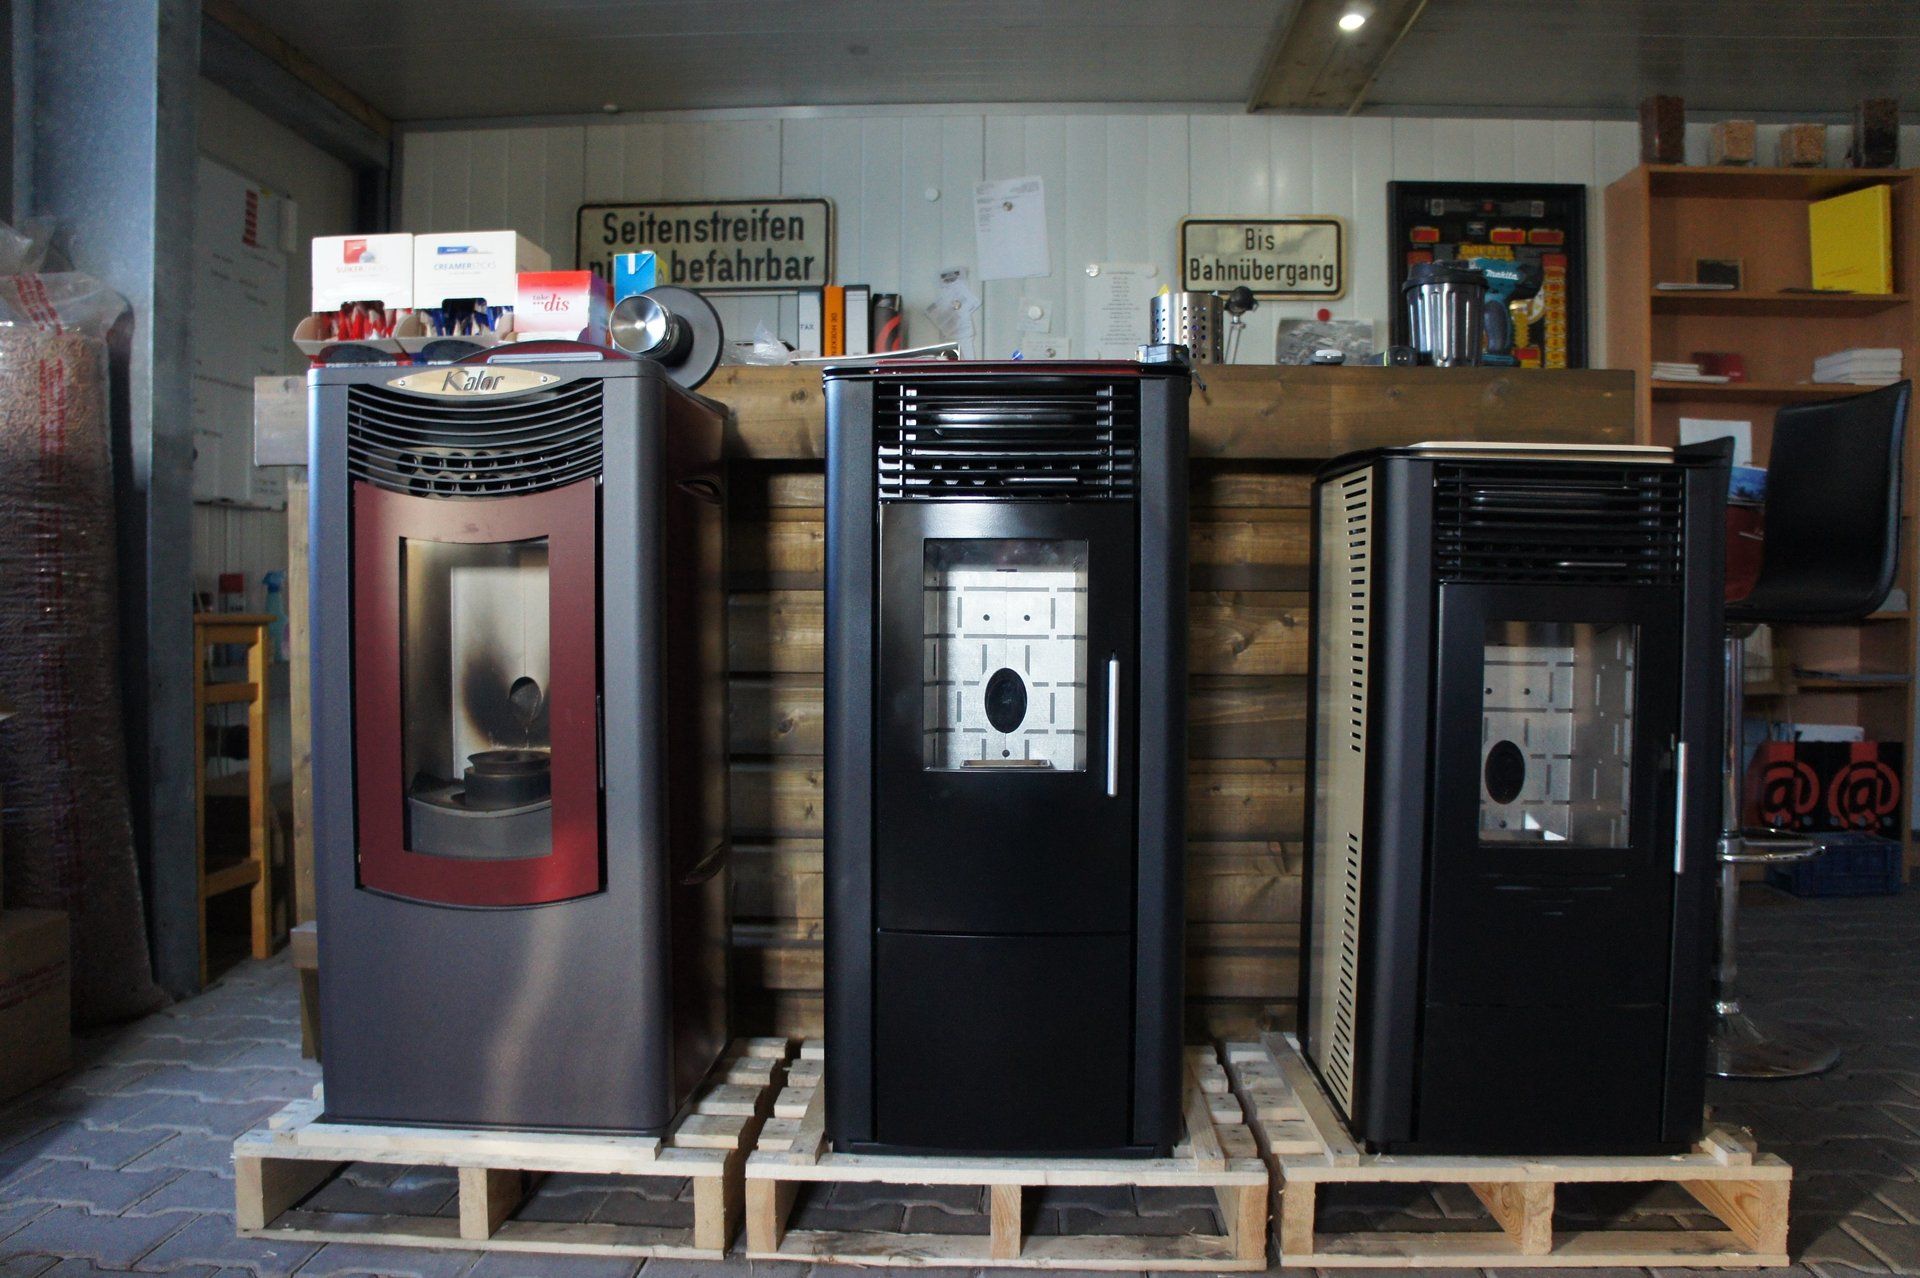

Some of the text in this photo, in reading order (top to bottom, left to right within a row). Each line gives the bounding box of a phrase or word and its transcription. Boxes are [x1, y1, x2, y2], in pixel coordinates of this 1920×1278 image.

[603, 208, 804, 245] Seitenstreifen
[1245, 228, 1275, 250] Bis
[671, 248, 815, 283] befahrbar
[1189, 258, 1334, 287] Bahnübergang
[441, 370, 505, 391] Kalor
